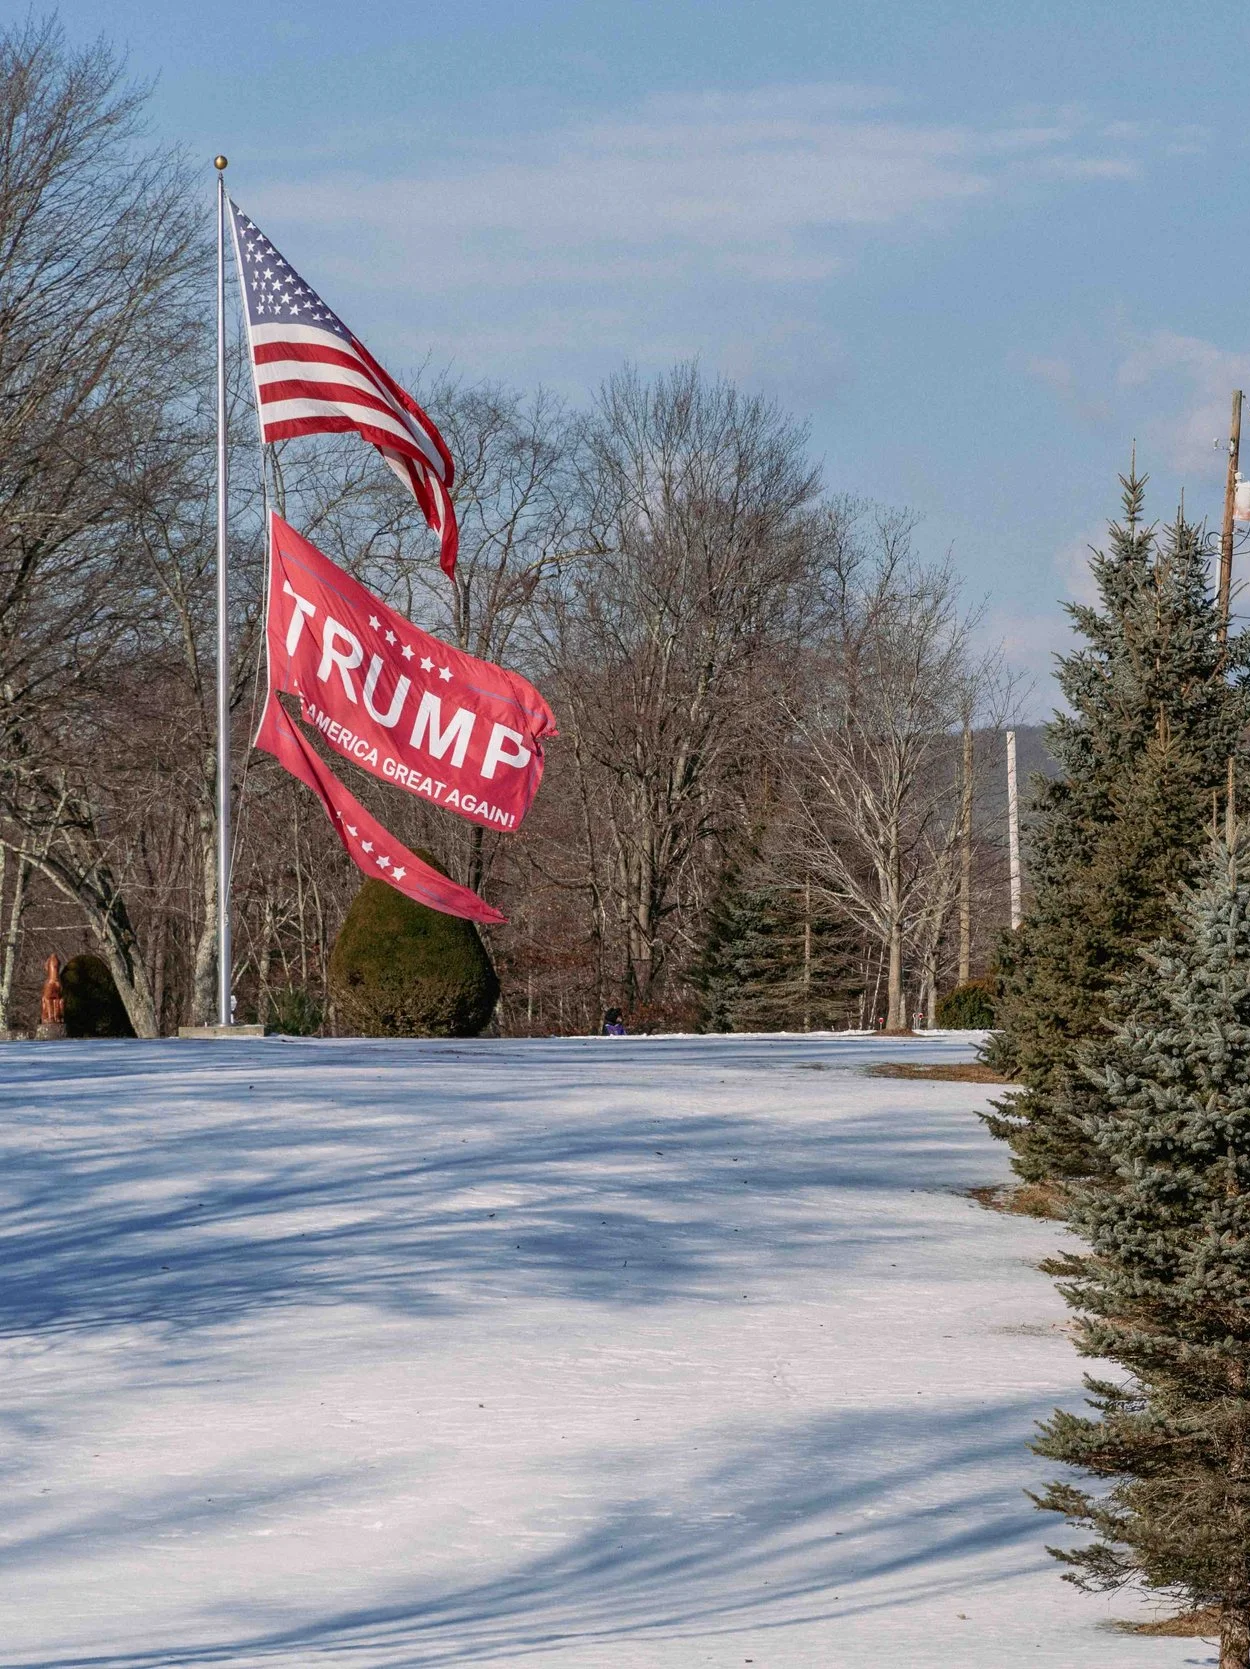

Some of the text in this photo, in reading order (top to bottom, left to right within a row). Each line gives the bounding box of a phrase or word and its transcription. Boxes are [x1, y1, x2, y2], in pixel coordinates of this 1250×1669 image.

[283, 579, 531, 779] TRUMP
[307, 703, 515, 828] AMERICA GREAT AGAIN!
